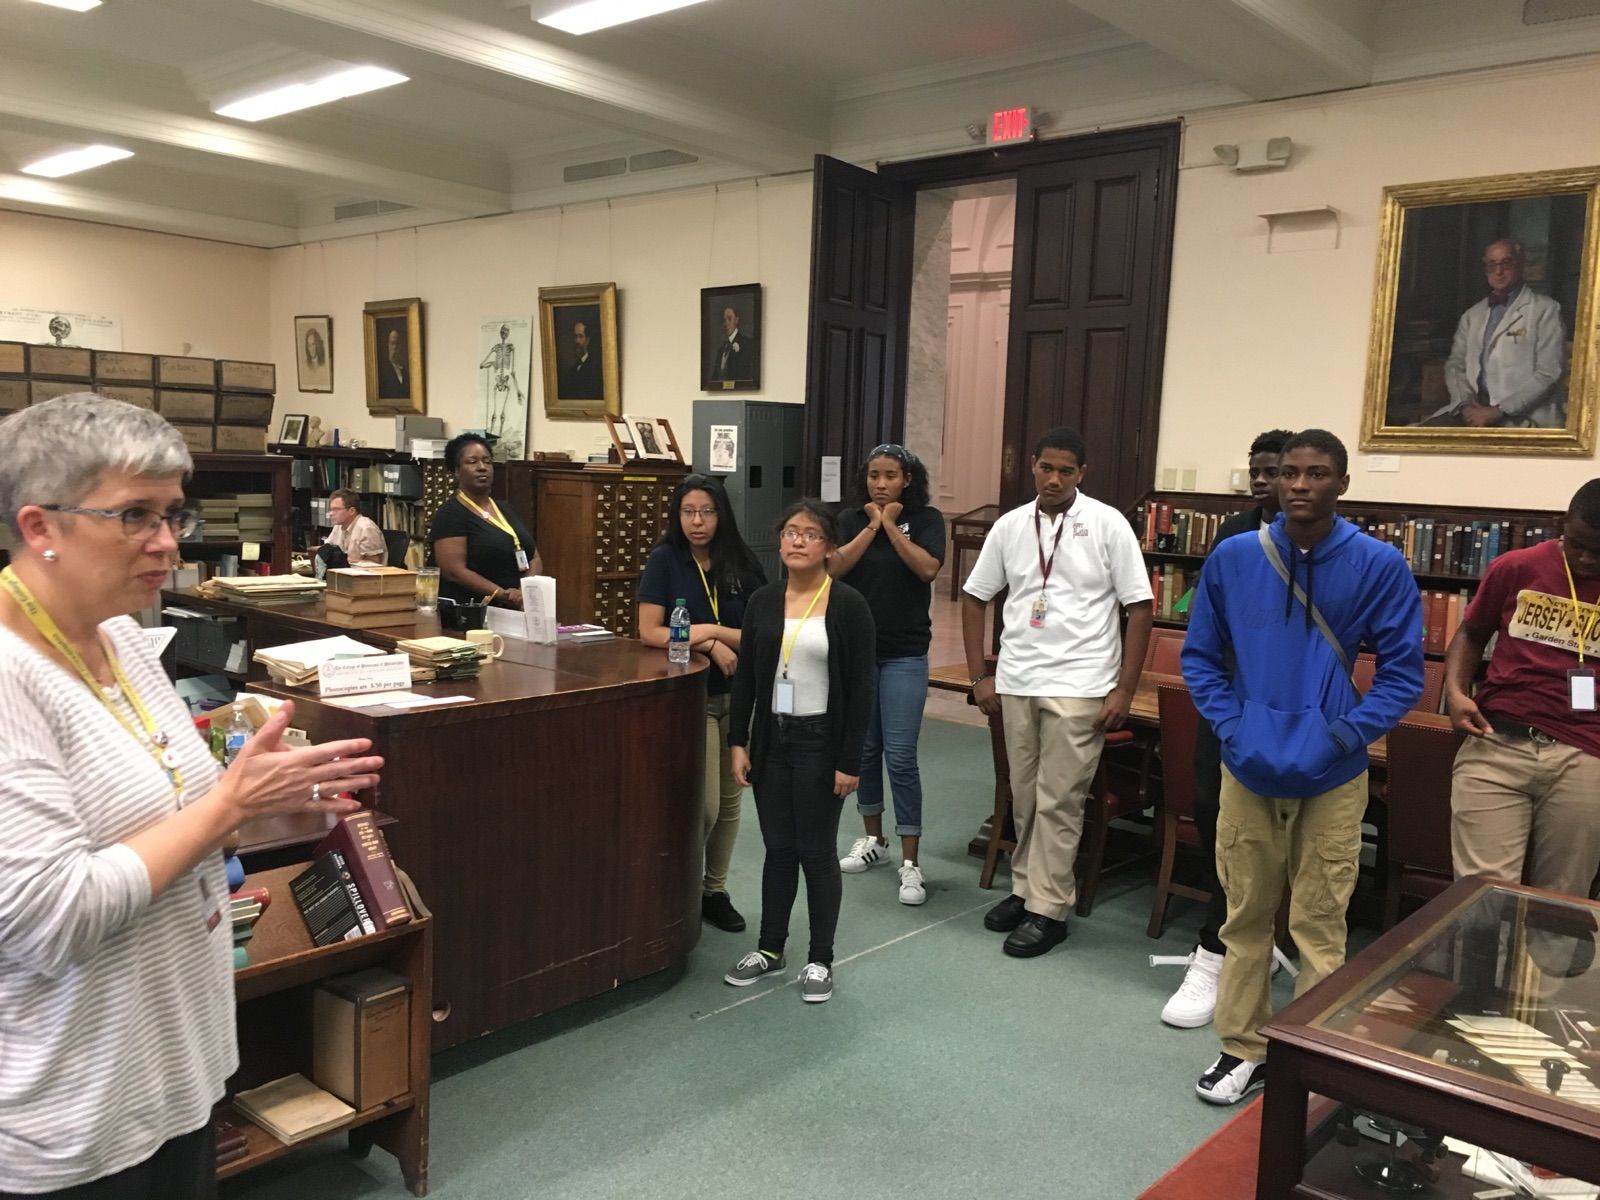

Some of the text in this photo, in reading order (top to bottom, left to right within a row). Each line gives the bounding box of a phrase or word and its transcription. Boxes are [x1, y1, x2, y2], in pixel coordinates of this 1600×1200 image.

[992, 108, 1026, 142] EXIT
[1532, 632, 1592, 651] Garden Ste
[325, 684, 358, 693] Photocopies
